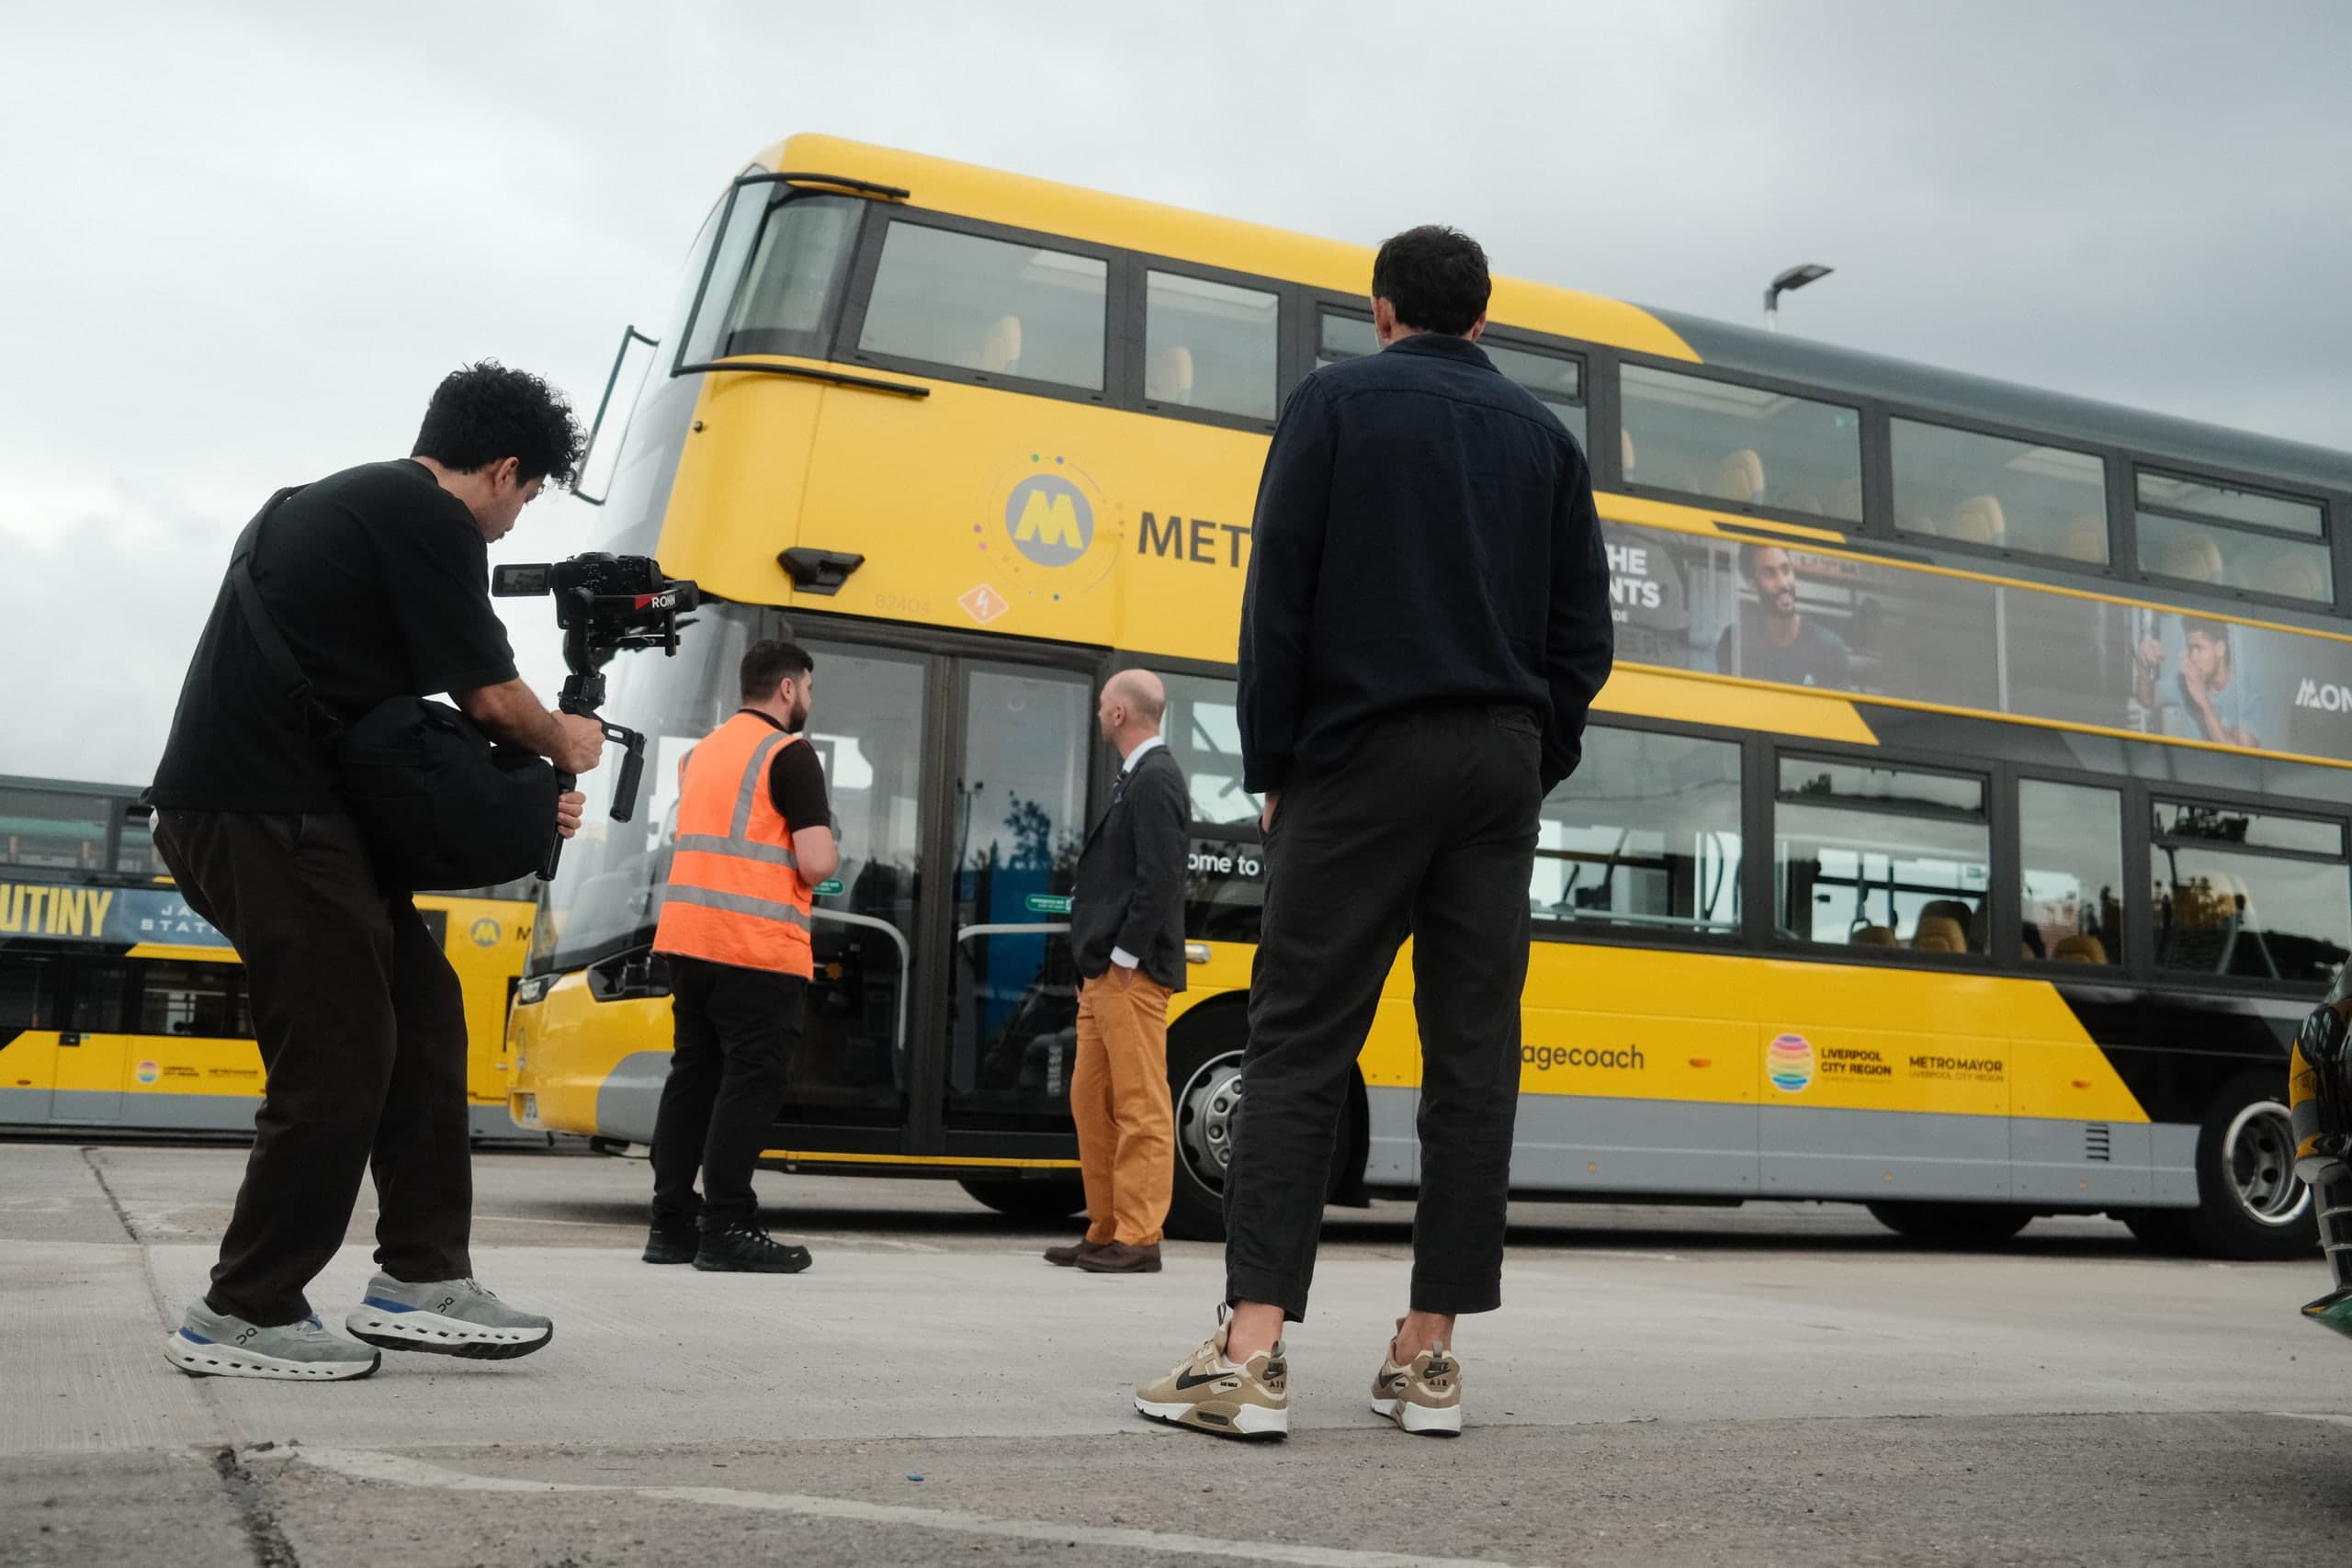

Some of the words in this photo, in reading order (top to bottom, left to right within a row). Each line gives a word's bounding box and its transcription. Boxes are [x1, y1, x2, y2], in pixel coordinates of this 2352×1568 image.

[1137, 511, 1250, 569] MET
[1604, 543, 1647, 575] HE
[1238, 855, 1260, 876] to
[1520, 1044, 1645, 1070] agecoach
[1821, 1047, 1883, 1063] LIVERPOOL
[1821, 1062, 1846, 1073] CITY
[1849, 1063, 1892, 1076] REGION
